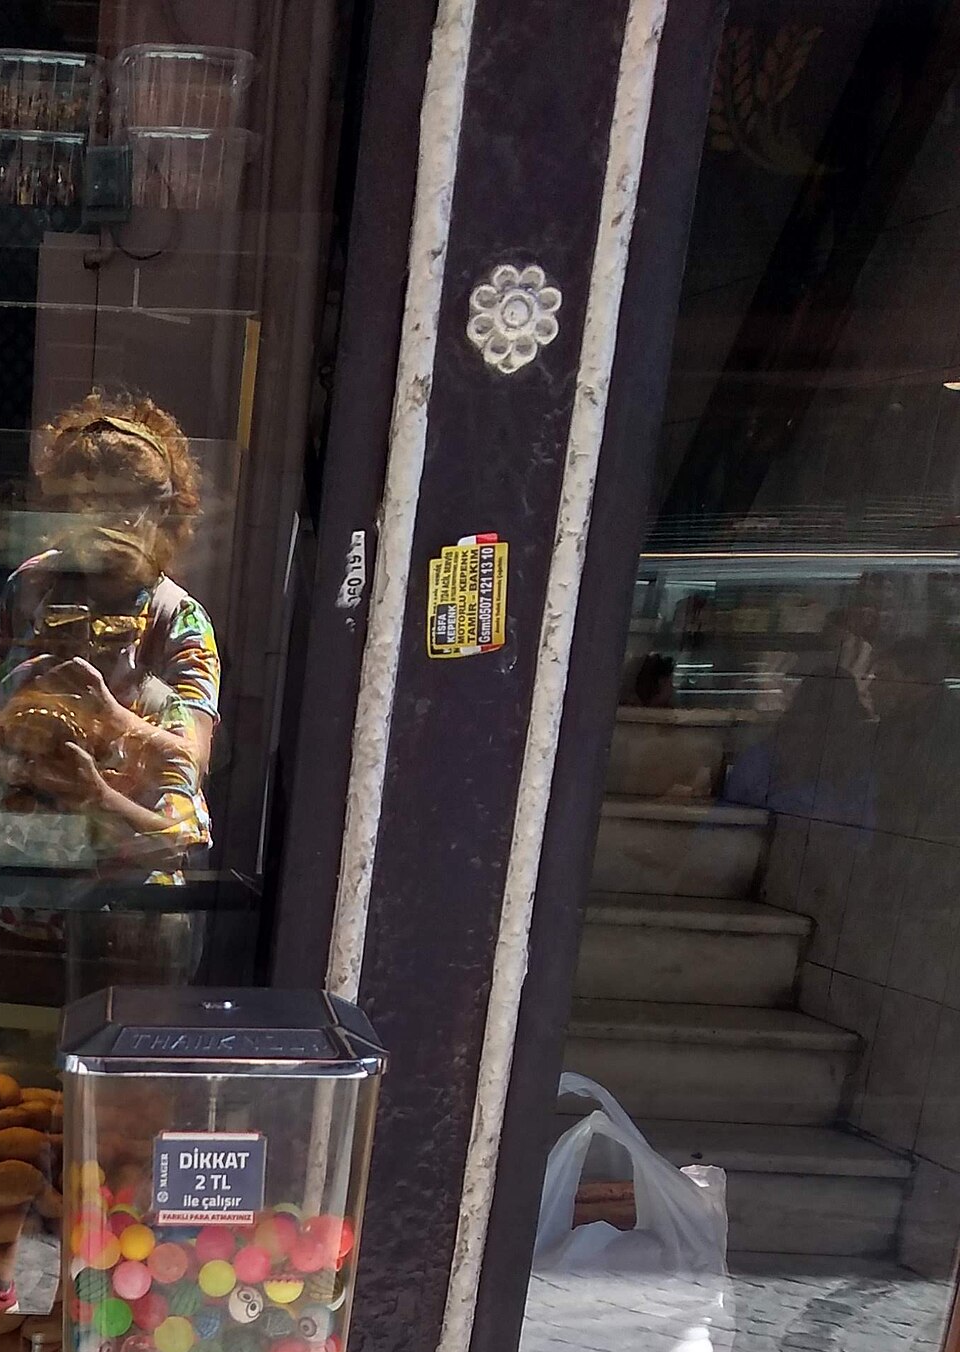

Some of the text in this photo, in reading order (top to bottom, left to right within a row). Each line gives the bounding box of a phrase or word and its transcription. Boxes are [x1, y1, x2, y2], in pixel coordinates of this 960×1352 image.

[469, 549, 479, 592] BAKIM
[458, 550, 469, 643] MOTORLU KEPENK
[479, 547, 494, 643] Gsm:0507 121 13 10
[447, 605, 457, 643] KEPENK
[467, 603, 477, 643] TAMİR
[179, 1147, 250, 1169] DİKKAT
[195, 1174, 231, 1190] 2 TL
[183, 1194, 242, 1210] ile çalışır
[190, 1213, 210, 1221] PARA
